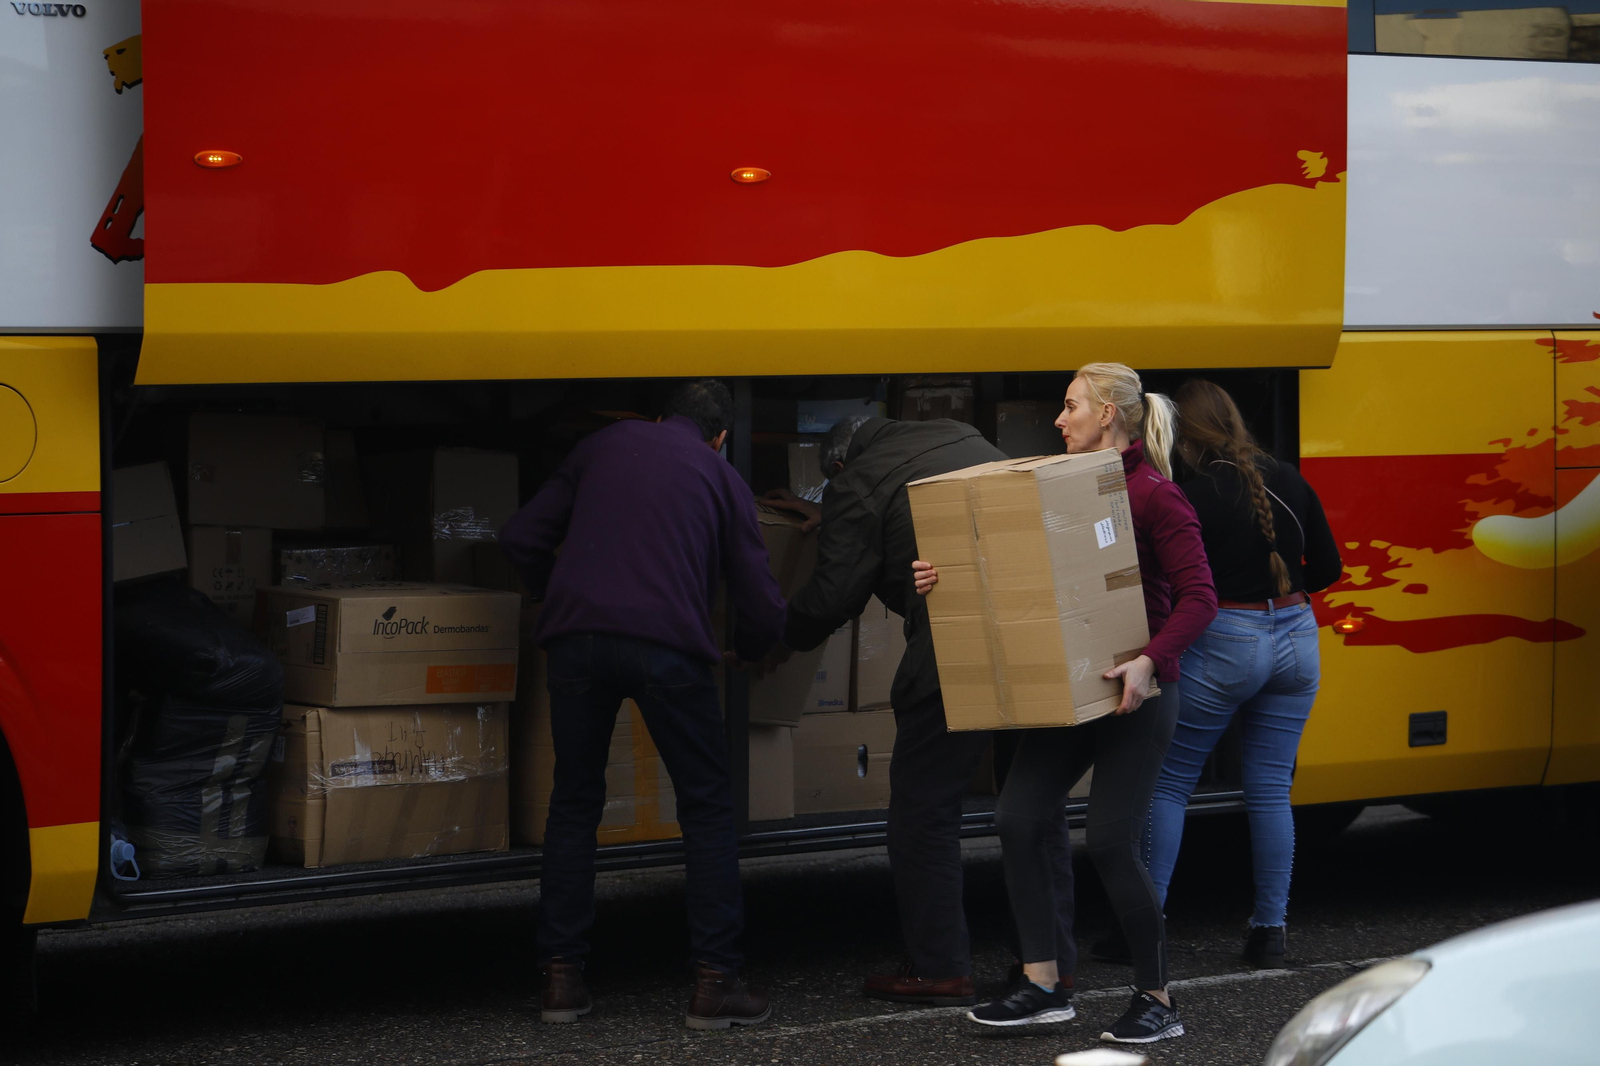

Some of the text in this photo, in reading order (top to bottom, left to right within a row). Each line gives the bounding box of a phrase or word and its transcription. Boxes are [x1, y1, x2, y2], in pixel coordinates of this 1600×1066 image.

[10, 2, 86, 18] VOLVO
[372, 616, 490, 636] IncoPack Dermobandas
